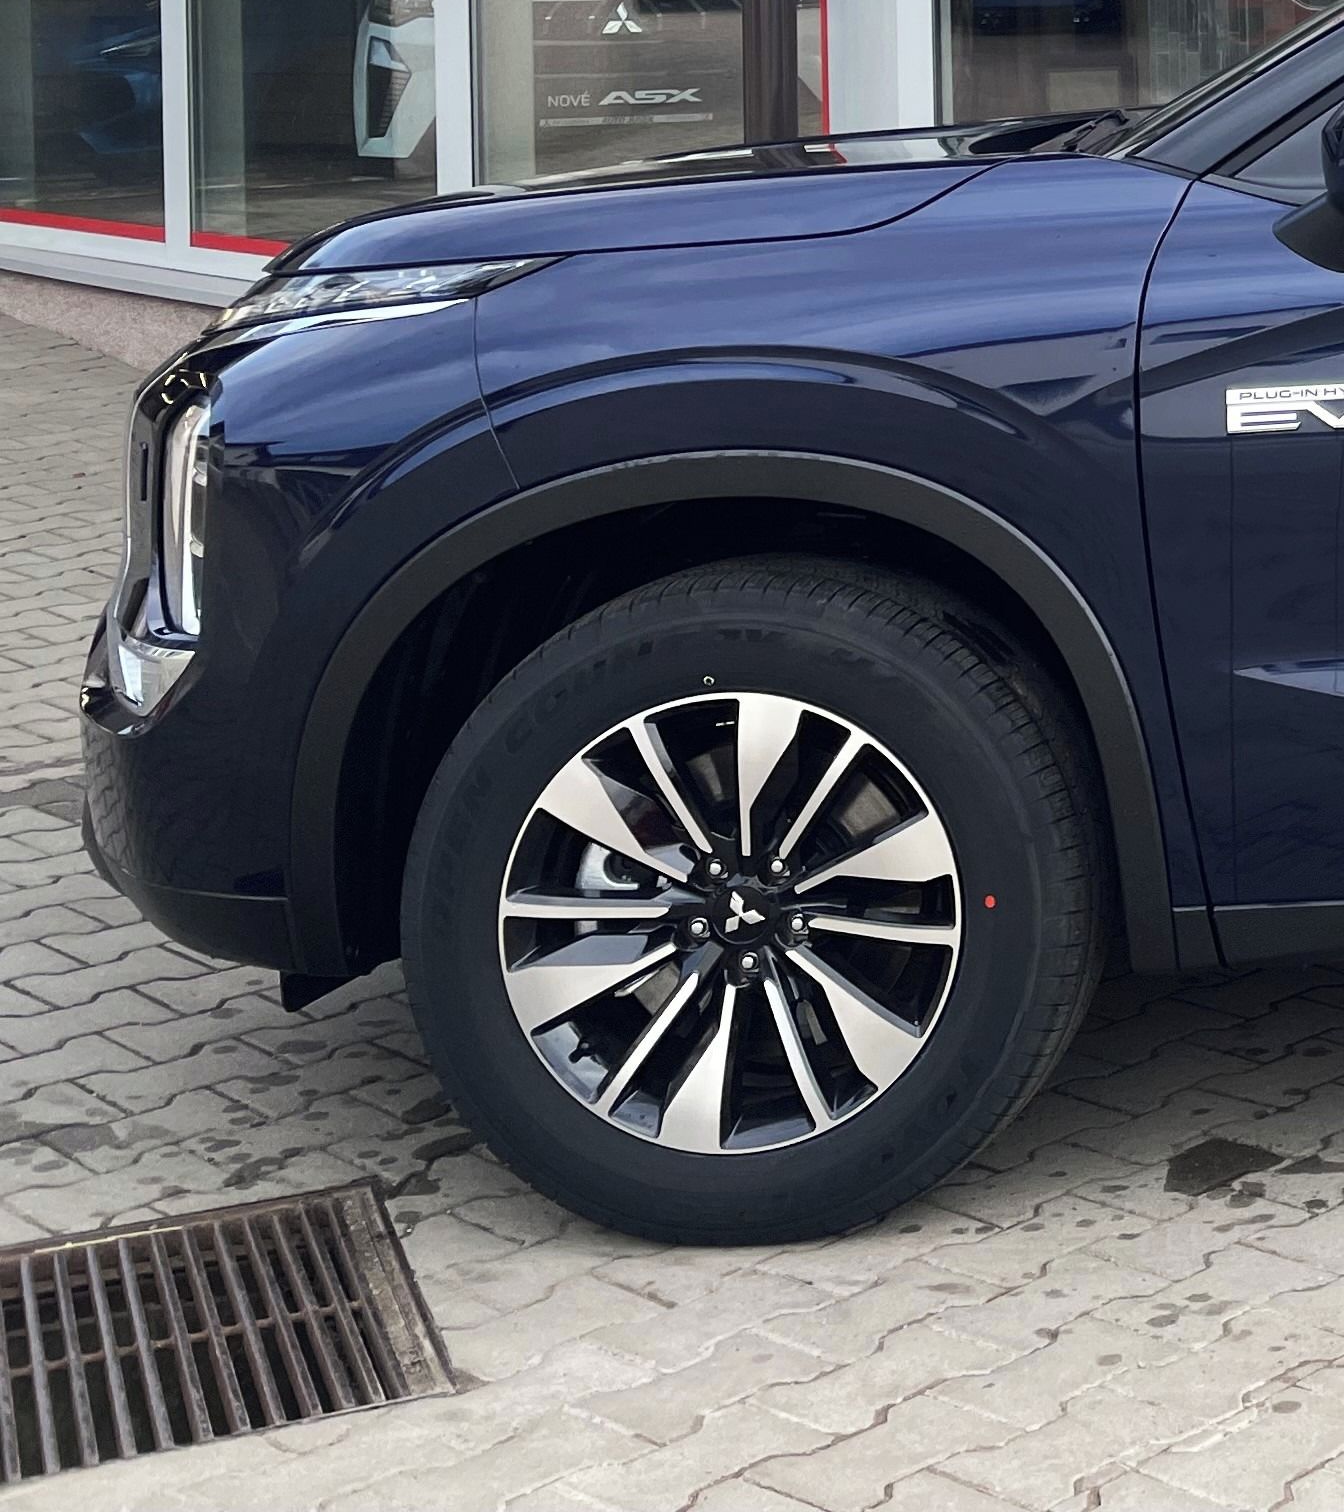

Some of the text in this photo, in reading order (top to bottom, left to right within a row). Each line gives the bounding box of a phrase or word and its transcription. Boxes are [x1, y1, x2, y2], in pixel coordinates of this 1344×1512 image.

[547, 88, 703, 107] NOVÉ ASX
[1238, 388, 1319, 401] PLUG-IN
